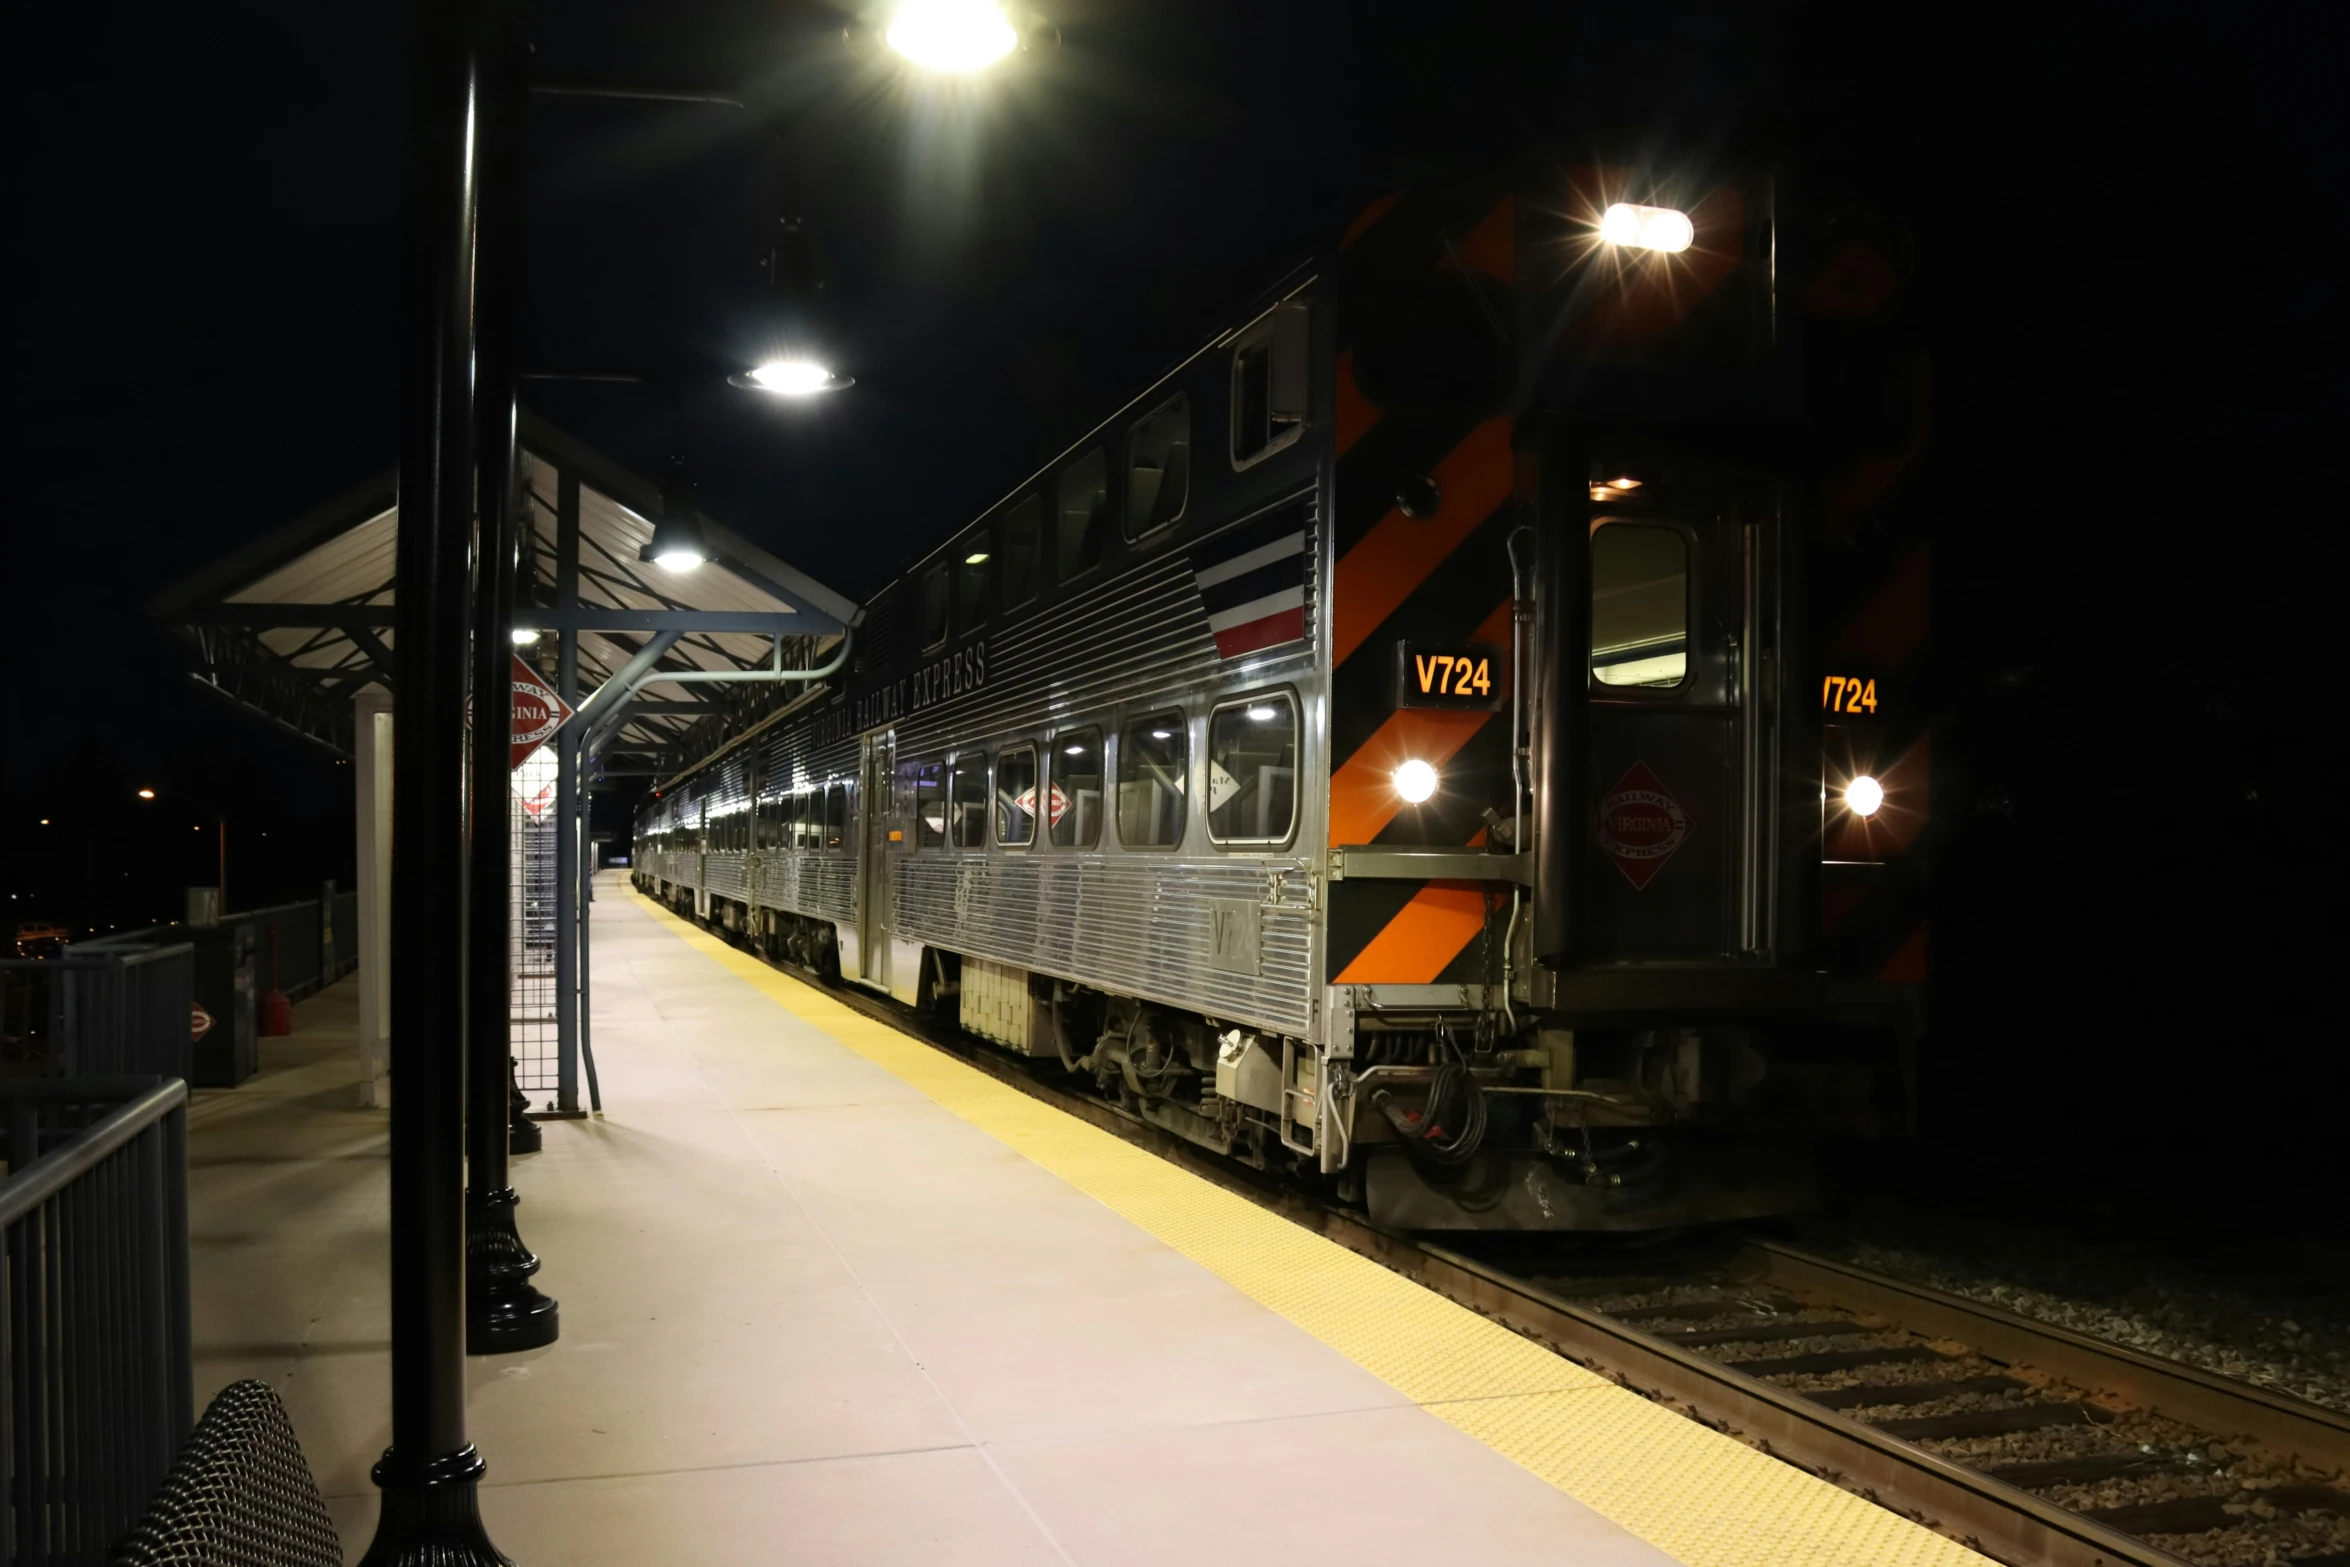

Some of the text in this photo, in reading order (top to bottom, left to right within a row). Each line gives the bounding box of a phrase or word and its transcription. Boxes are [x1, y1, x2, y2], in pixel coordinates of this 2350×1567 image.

[1415, 654, 1491, 696] V724
[857, 678, 908, 732] RAILWAY
[912, 641, 986, 710] EXPRESS
[1606, 792, 1675, 810] RAILWAY
[1608, 816, 1672, 832] VIRGINIA
[1605, 838, 1675, 857] EXPRESS
[1312, 998, 1319, 1023] F
